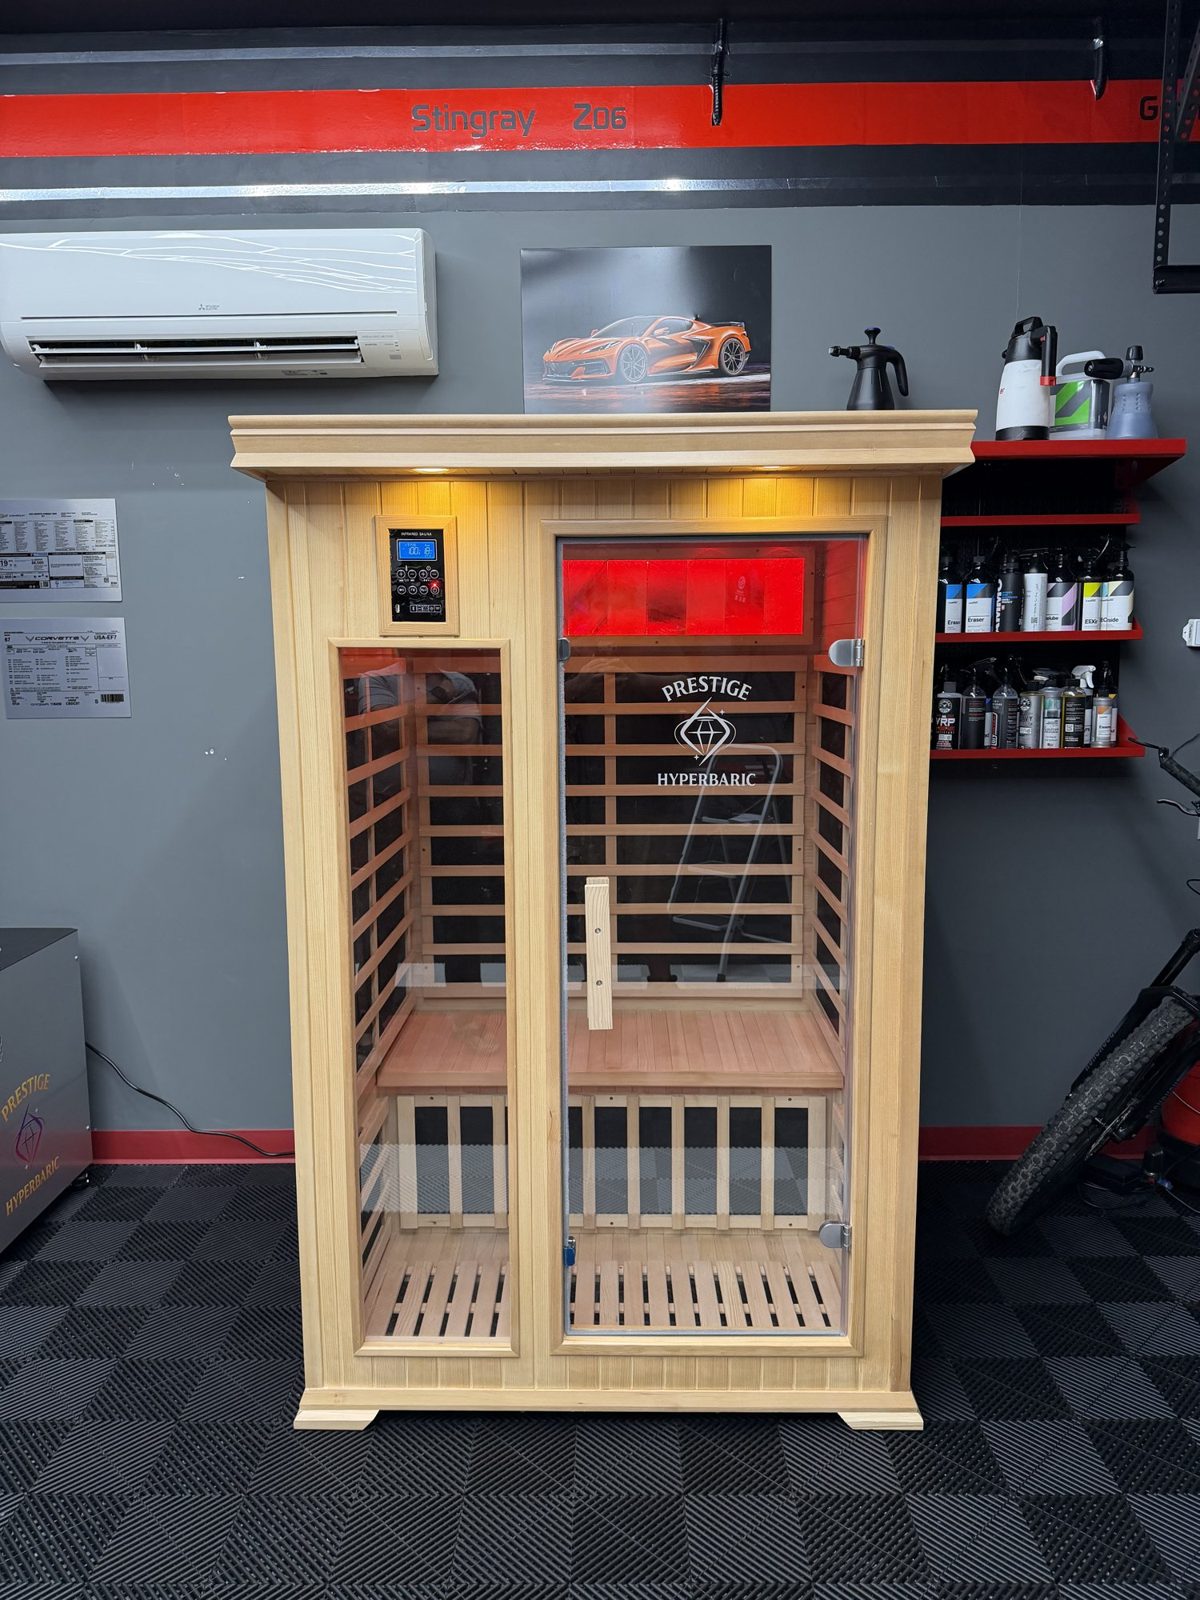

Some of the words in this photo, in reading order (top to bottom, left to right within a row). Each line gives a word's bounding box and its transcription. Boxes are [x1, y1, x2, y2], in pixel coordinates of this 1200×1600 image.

[411, 104, 536, 138] Stingray
[572, 103, 628, 131] Z06
[661, 675, 752, 702] PRESTIGE
[935, 717, 956, 727] VRP
[657, 772, 756, 786] HYPERBARIC
[1, 1072, 51, 1122] PRESTIGE
[5, 1155, 60, 1216] HYPERBARIC
